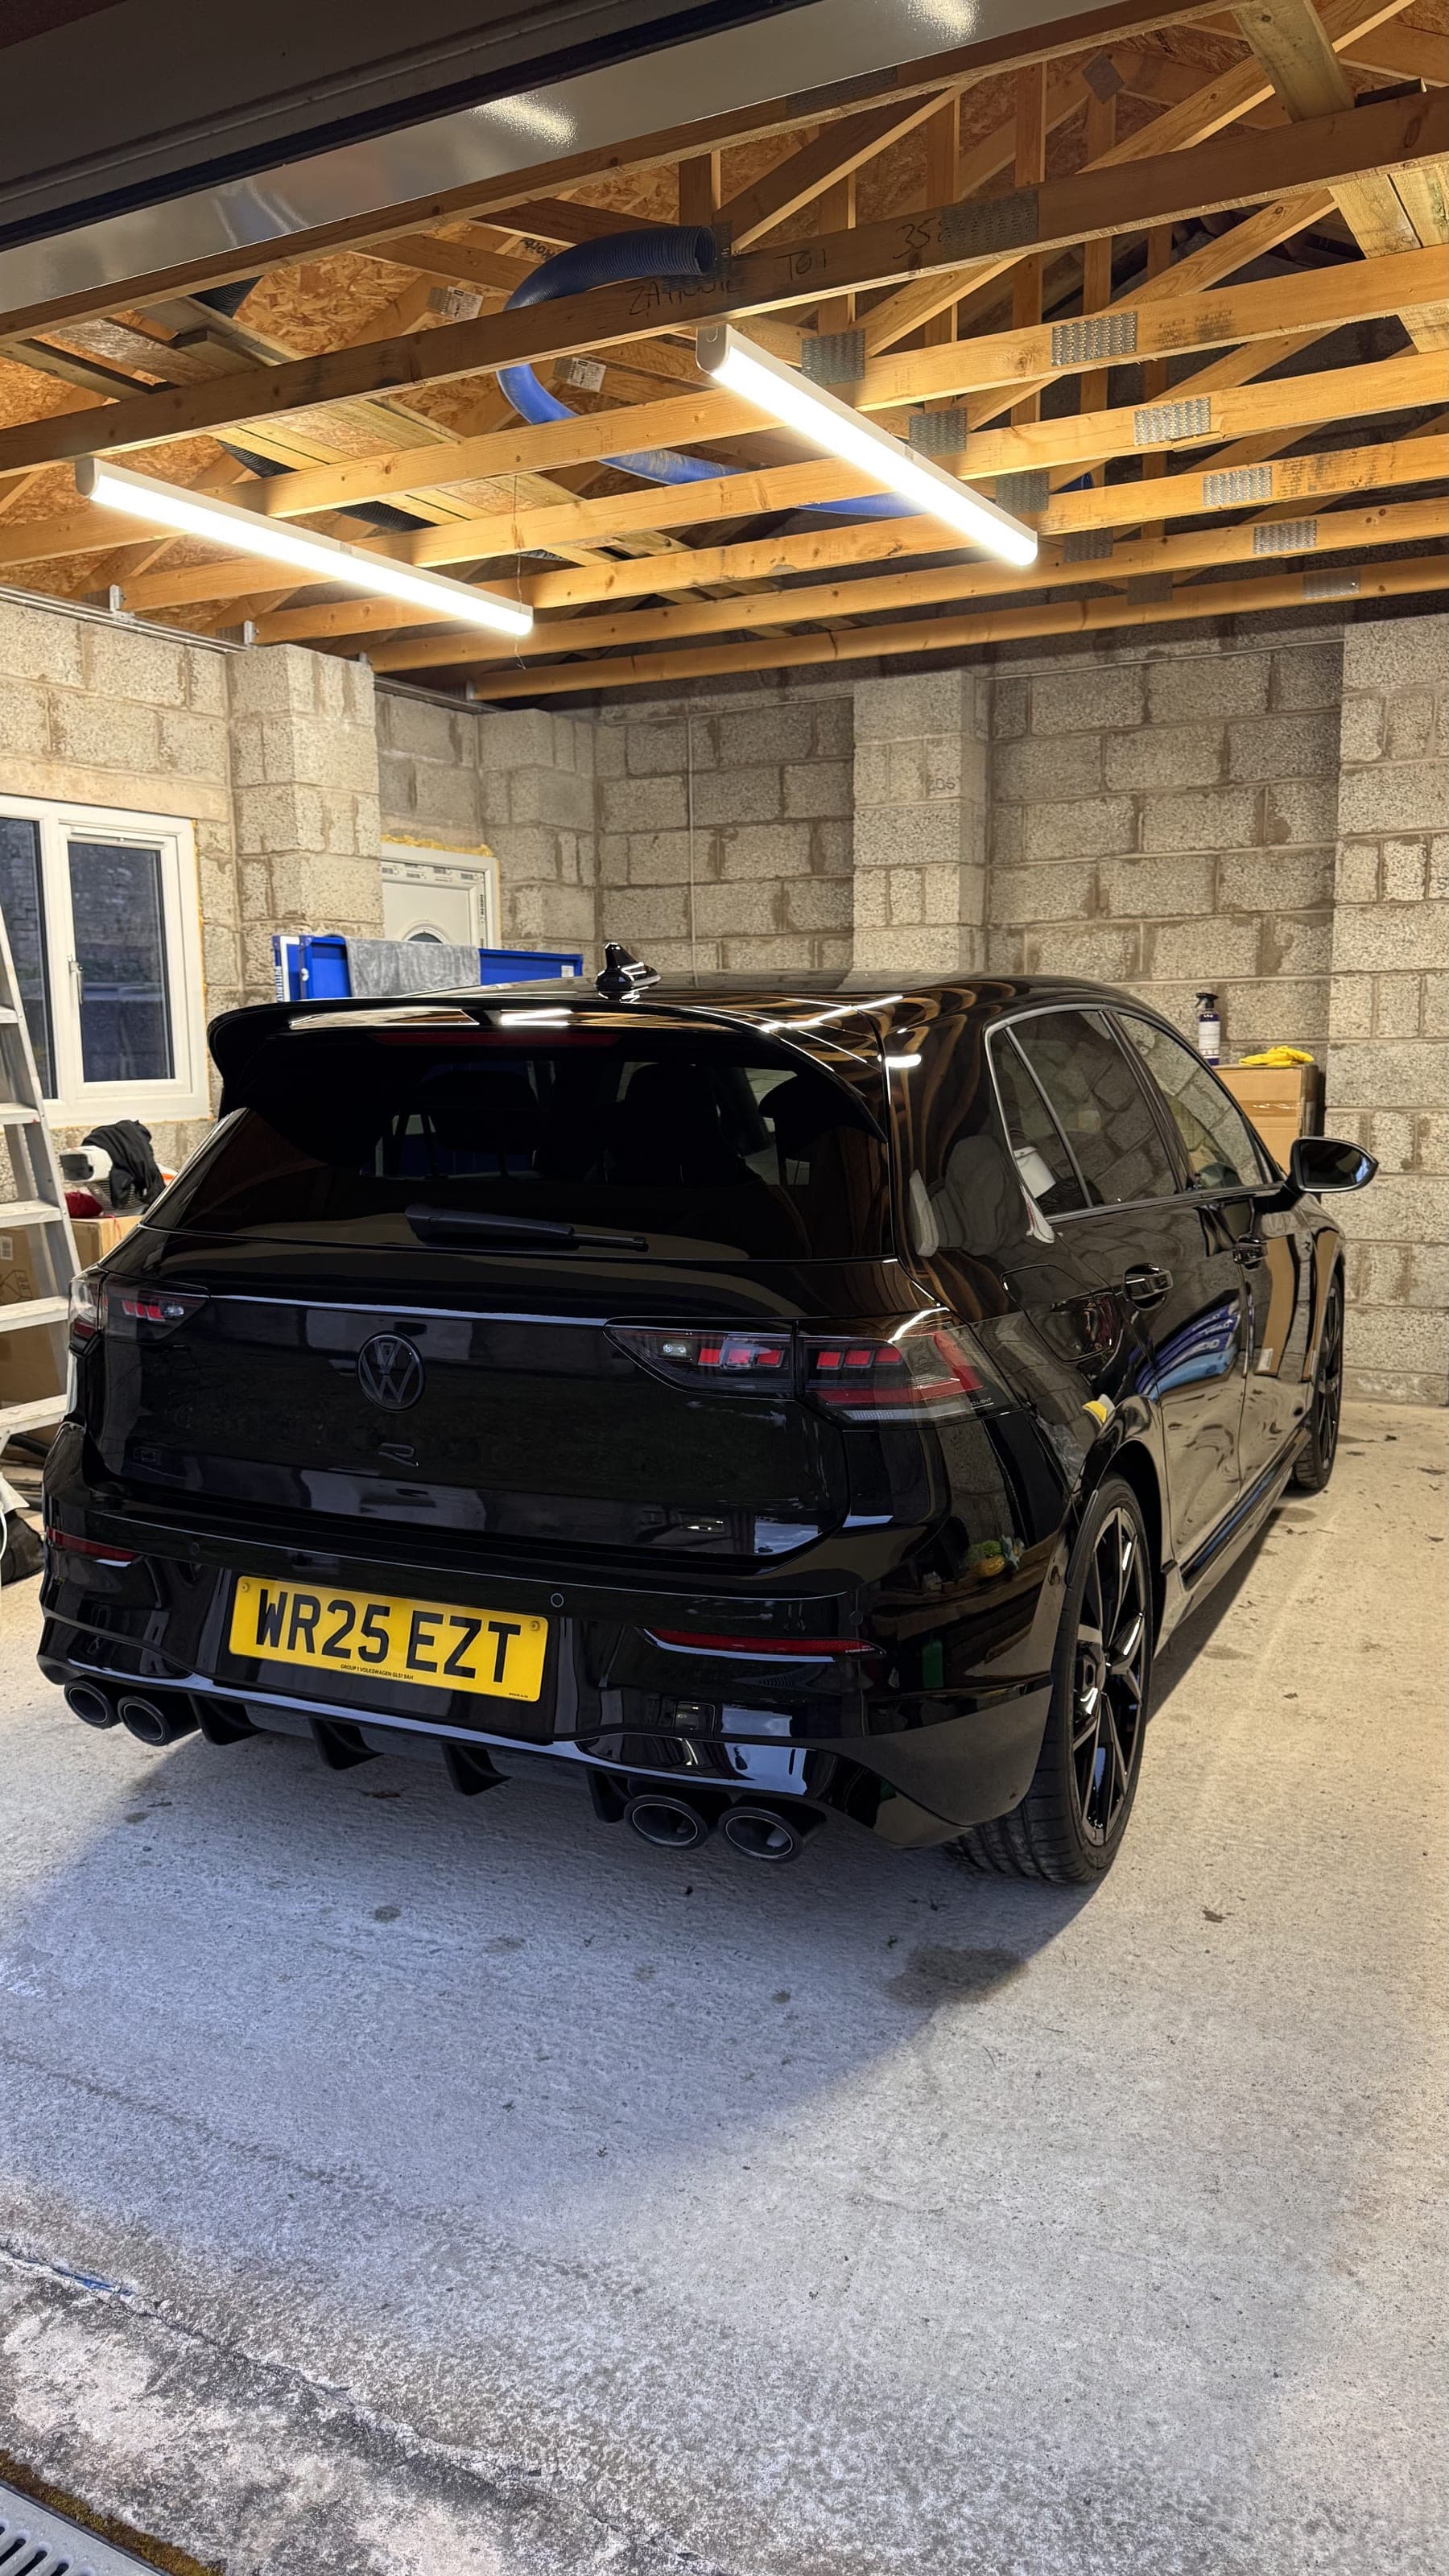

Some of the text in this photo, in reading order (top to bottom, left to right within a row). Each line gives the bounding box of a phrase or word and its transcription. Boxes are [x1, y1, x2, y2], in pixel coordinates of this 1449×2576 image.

[256, 1588, 521, 1683] WR25 EZT
[360, 1667, 392, 1676] VOLKSWAGEN
